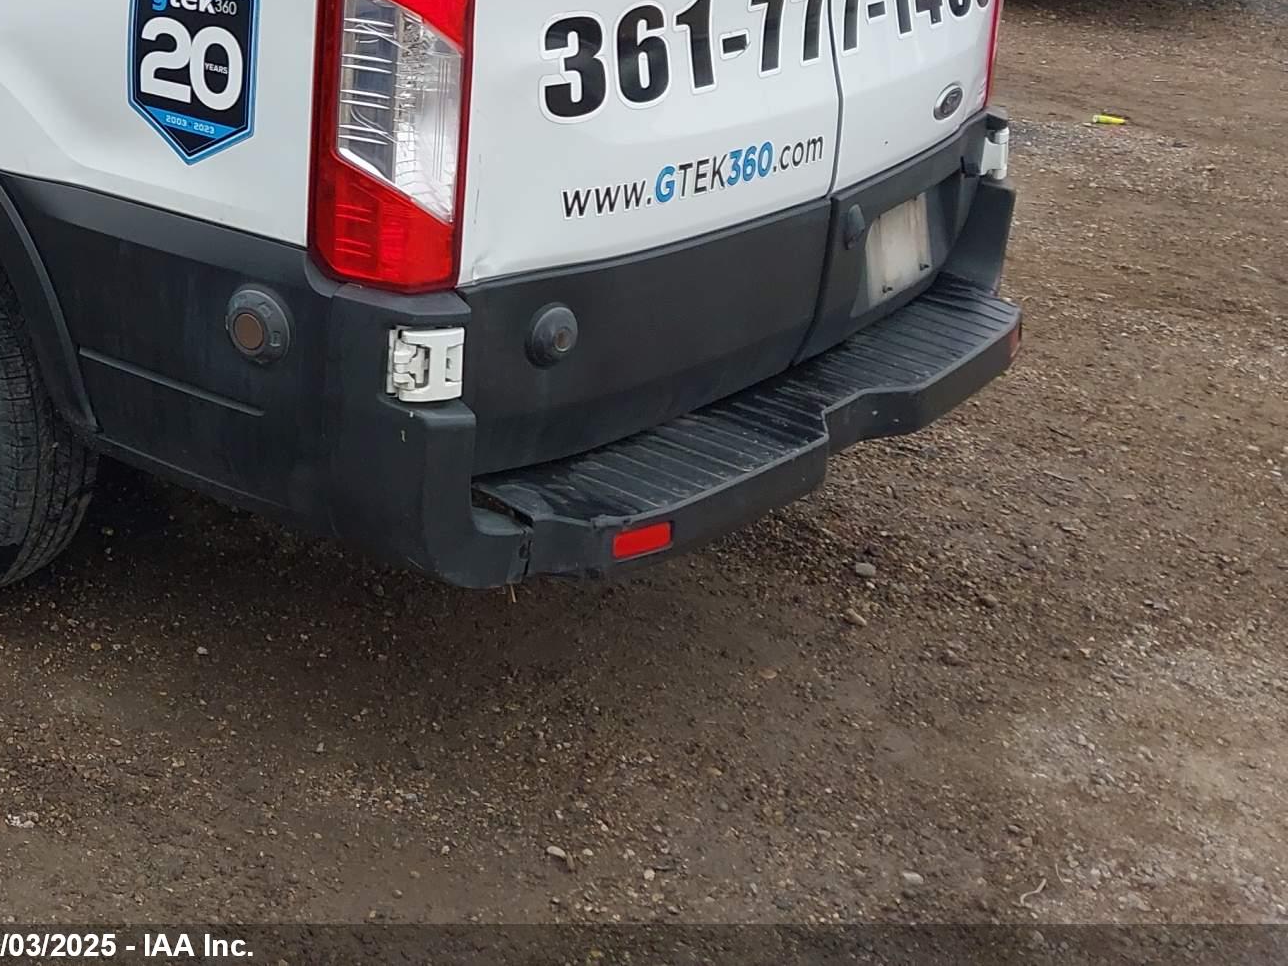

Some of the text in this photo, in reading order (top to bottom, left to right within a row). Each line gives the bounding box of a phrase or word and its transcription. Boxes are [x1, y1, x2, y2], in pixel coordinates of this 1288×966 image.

[140, 17, 243, 111] 20
[204, 62, 228, 75] YEARS
[562, 135, 824, 218] www.GTEK360.com
